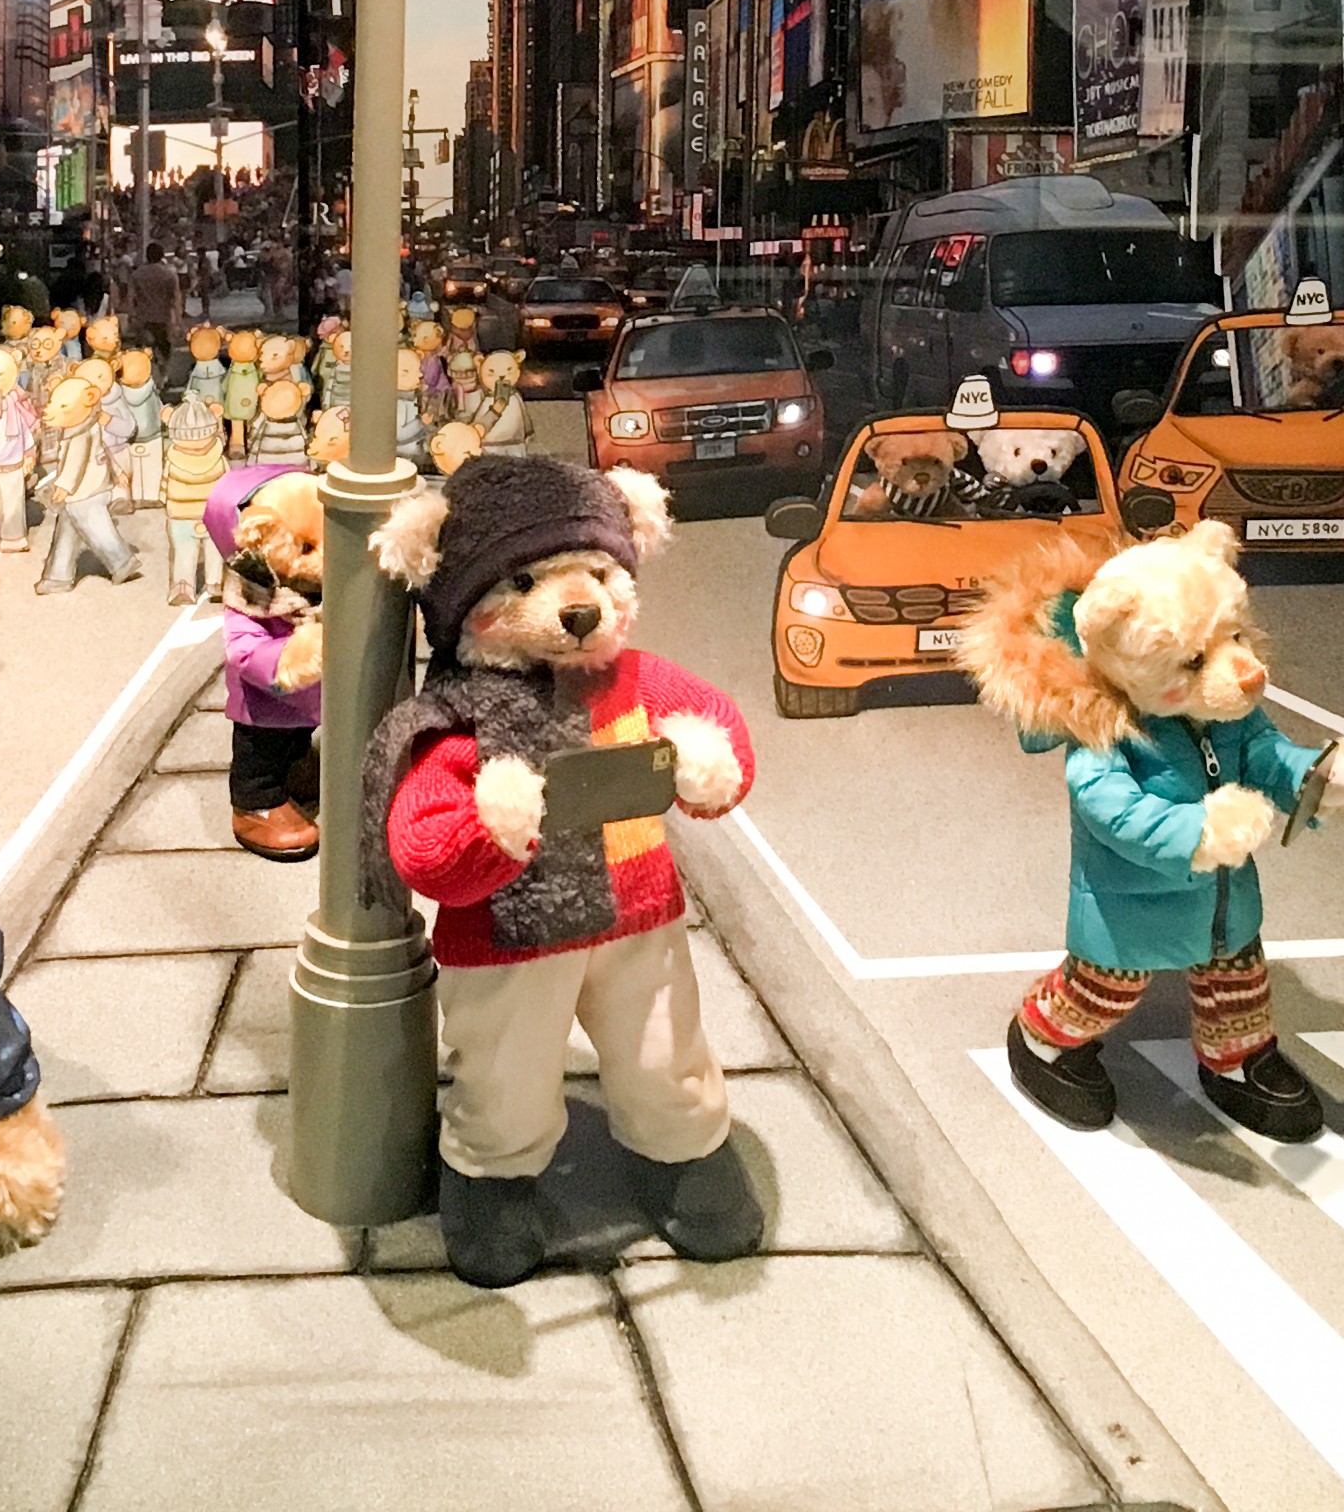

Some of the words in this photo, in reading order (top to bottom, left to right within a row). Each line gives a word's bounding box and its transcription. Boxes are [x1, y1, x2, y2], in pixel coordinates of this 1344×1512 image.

[120, 53, 140, 65] LIV
[691, 21, 706, 153] PALACE
[968, 75, 1013, 90] COMEDY
[1296, 292, 1325, 306] NYC
[960, 391, 989, 404] NYC
[1258, 521, 1295, 537] NYC
[1301, 521, 1340, 536] 5890
